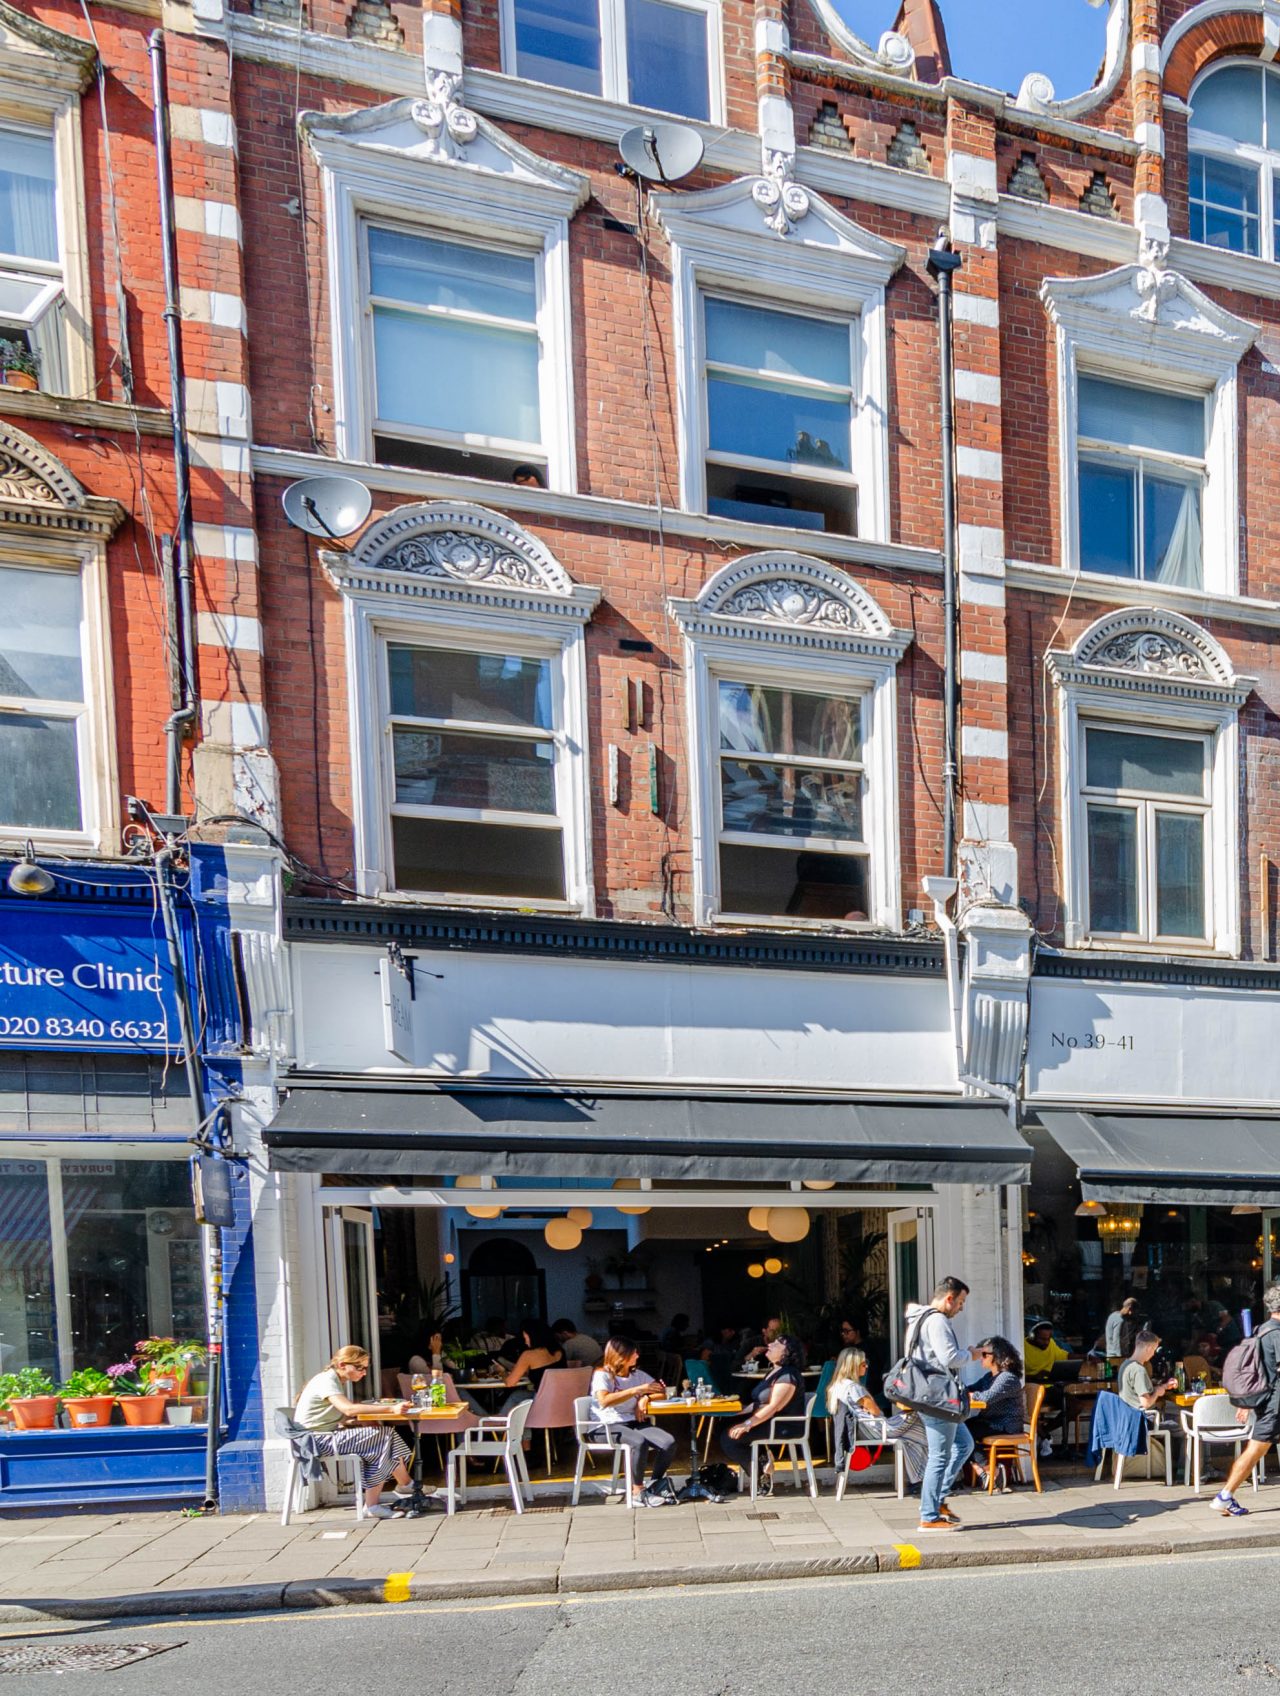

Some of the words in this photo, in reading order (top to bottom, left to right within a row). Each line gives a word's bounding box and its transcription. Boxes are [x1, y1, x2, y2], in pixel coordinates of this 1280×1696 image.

[72, 962, 163, 992] Clinic
[46, 1018, 104, 1038] 8340
[110, 1020, 167, 1041] 6632
[1051, 1032, 1078, 1049] No
